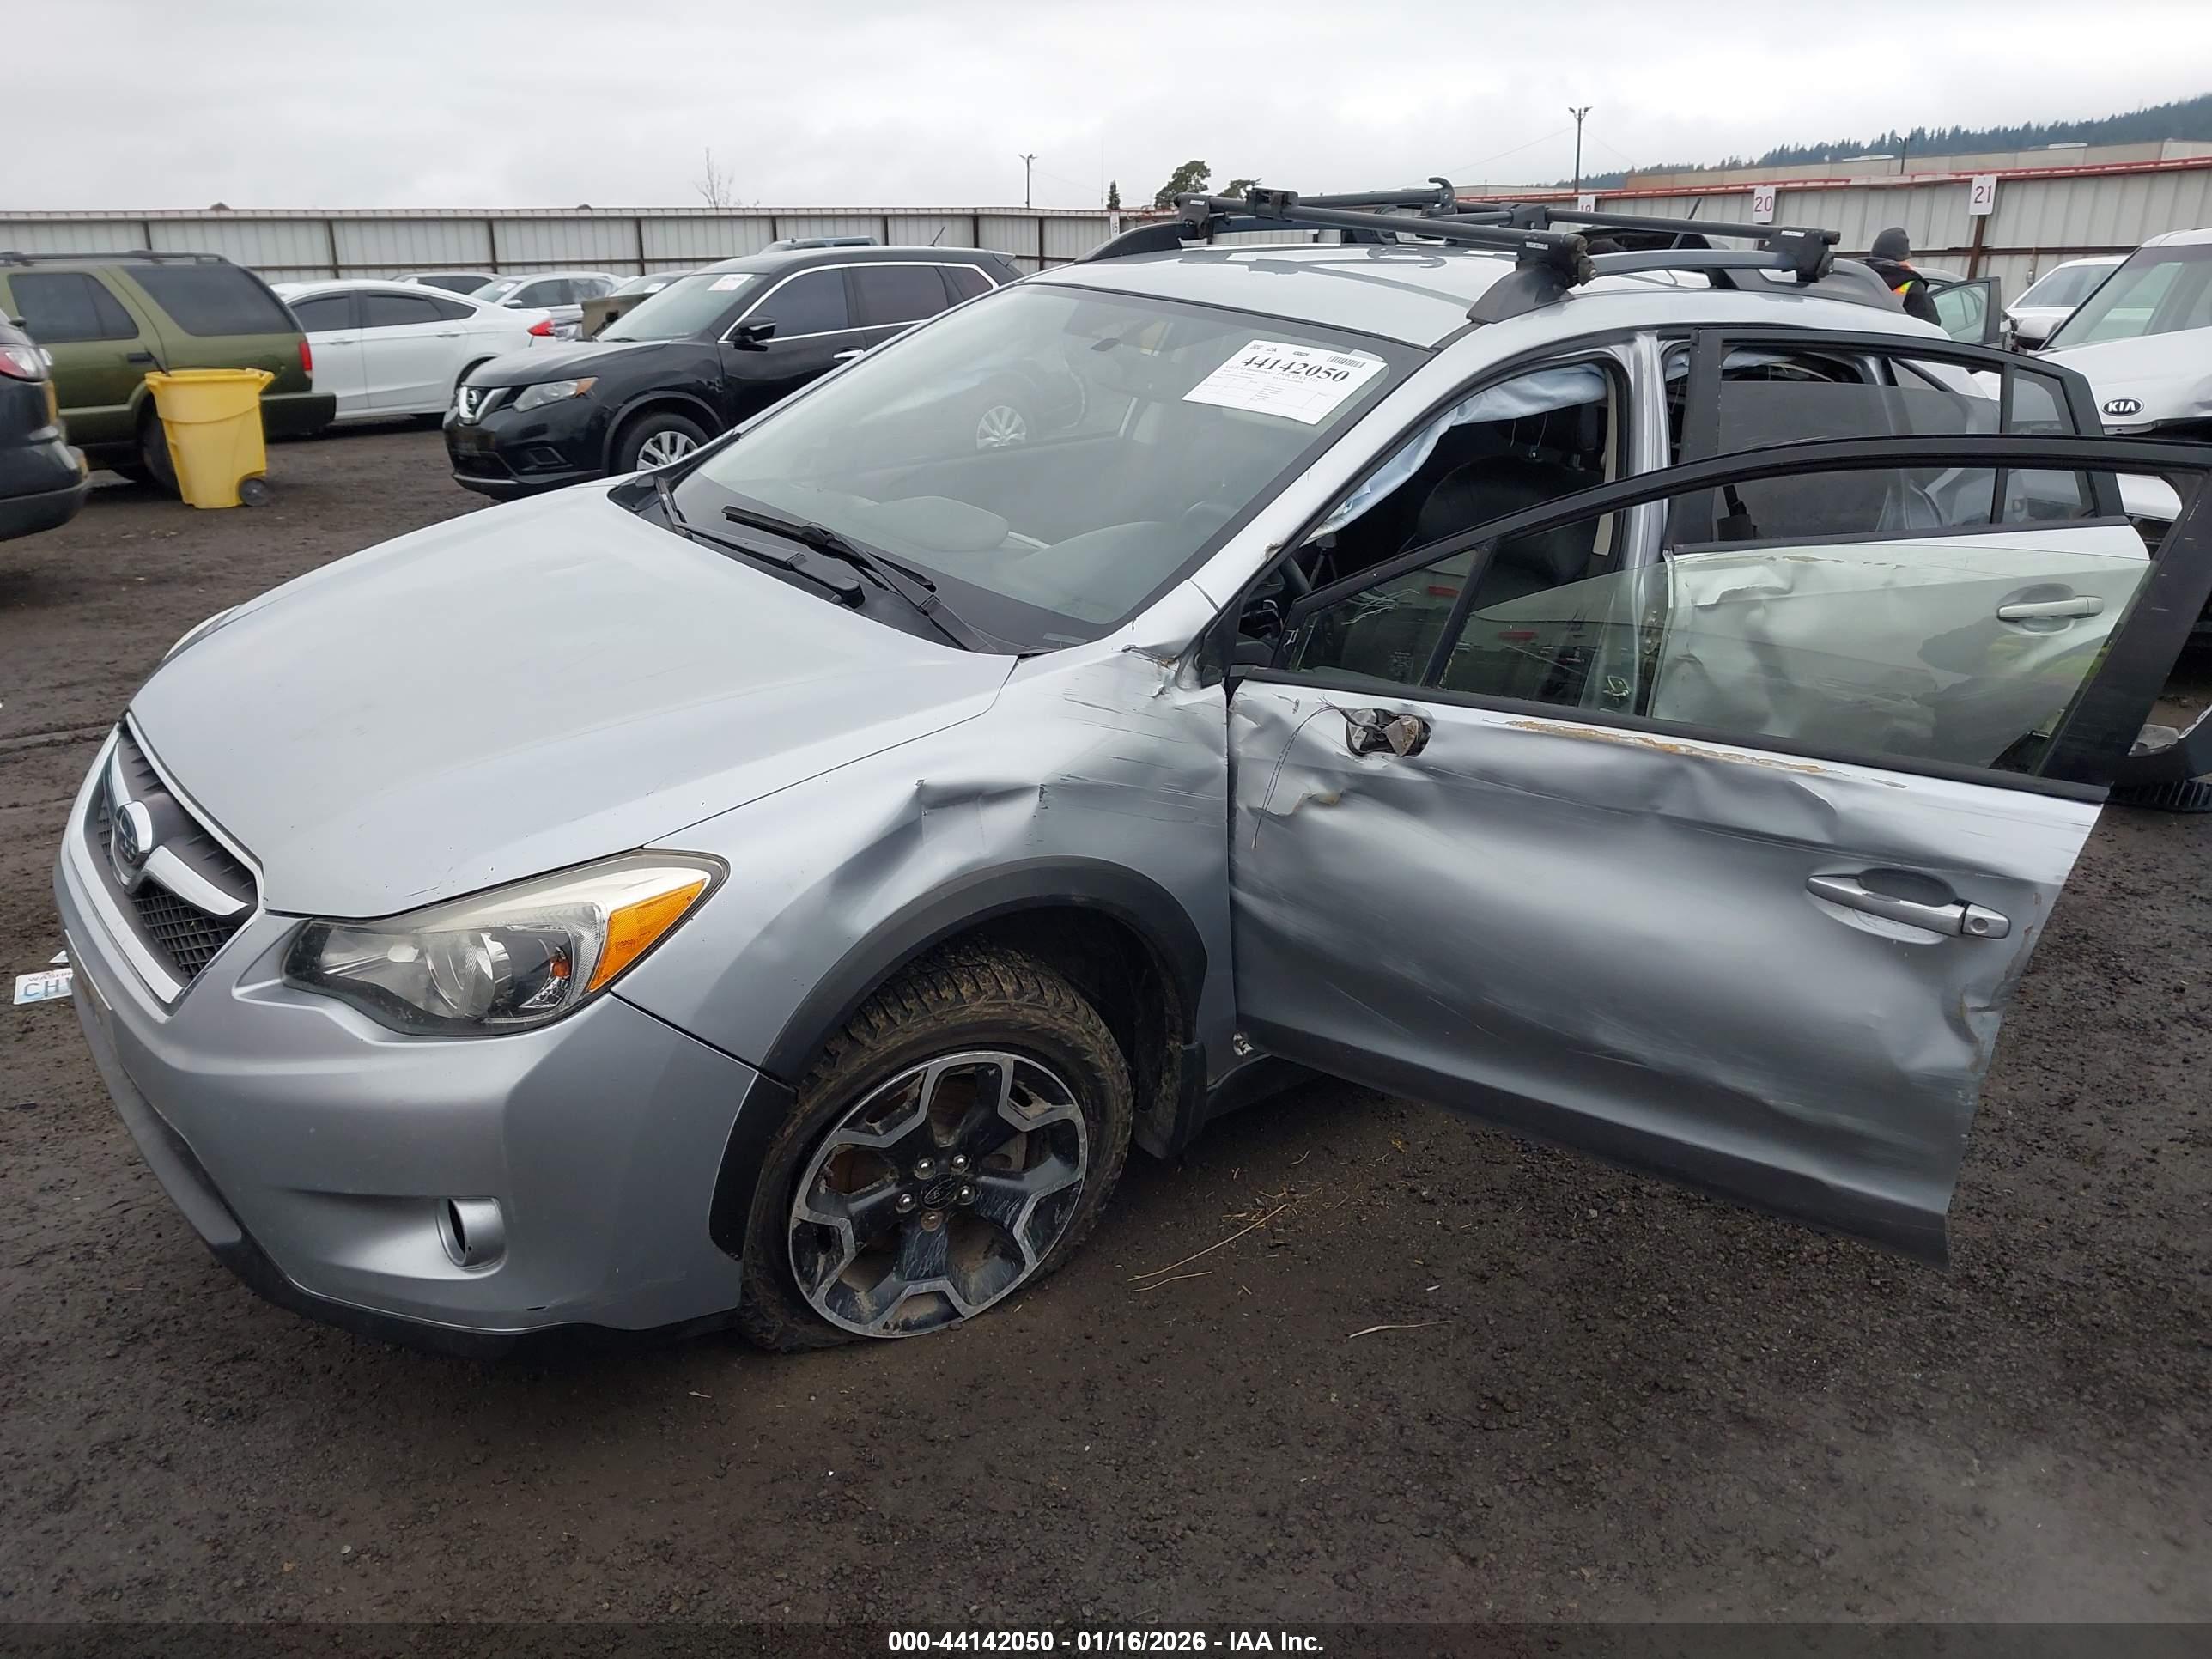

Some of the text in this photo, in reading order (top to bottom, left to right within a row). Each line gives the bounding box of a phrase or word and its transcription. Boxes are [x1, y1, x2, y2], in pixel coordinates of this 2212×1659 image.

[1974, 185, 1992, 204] 21
[1754, 196, 1773, 212] 20
[1241, 355, 1350, 383] 44142050
[2108, 400, 2136, 412] KIA
